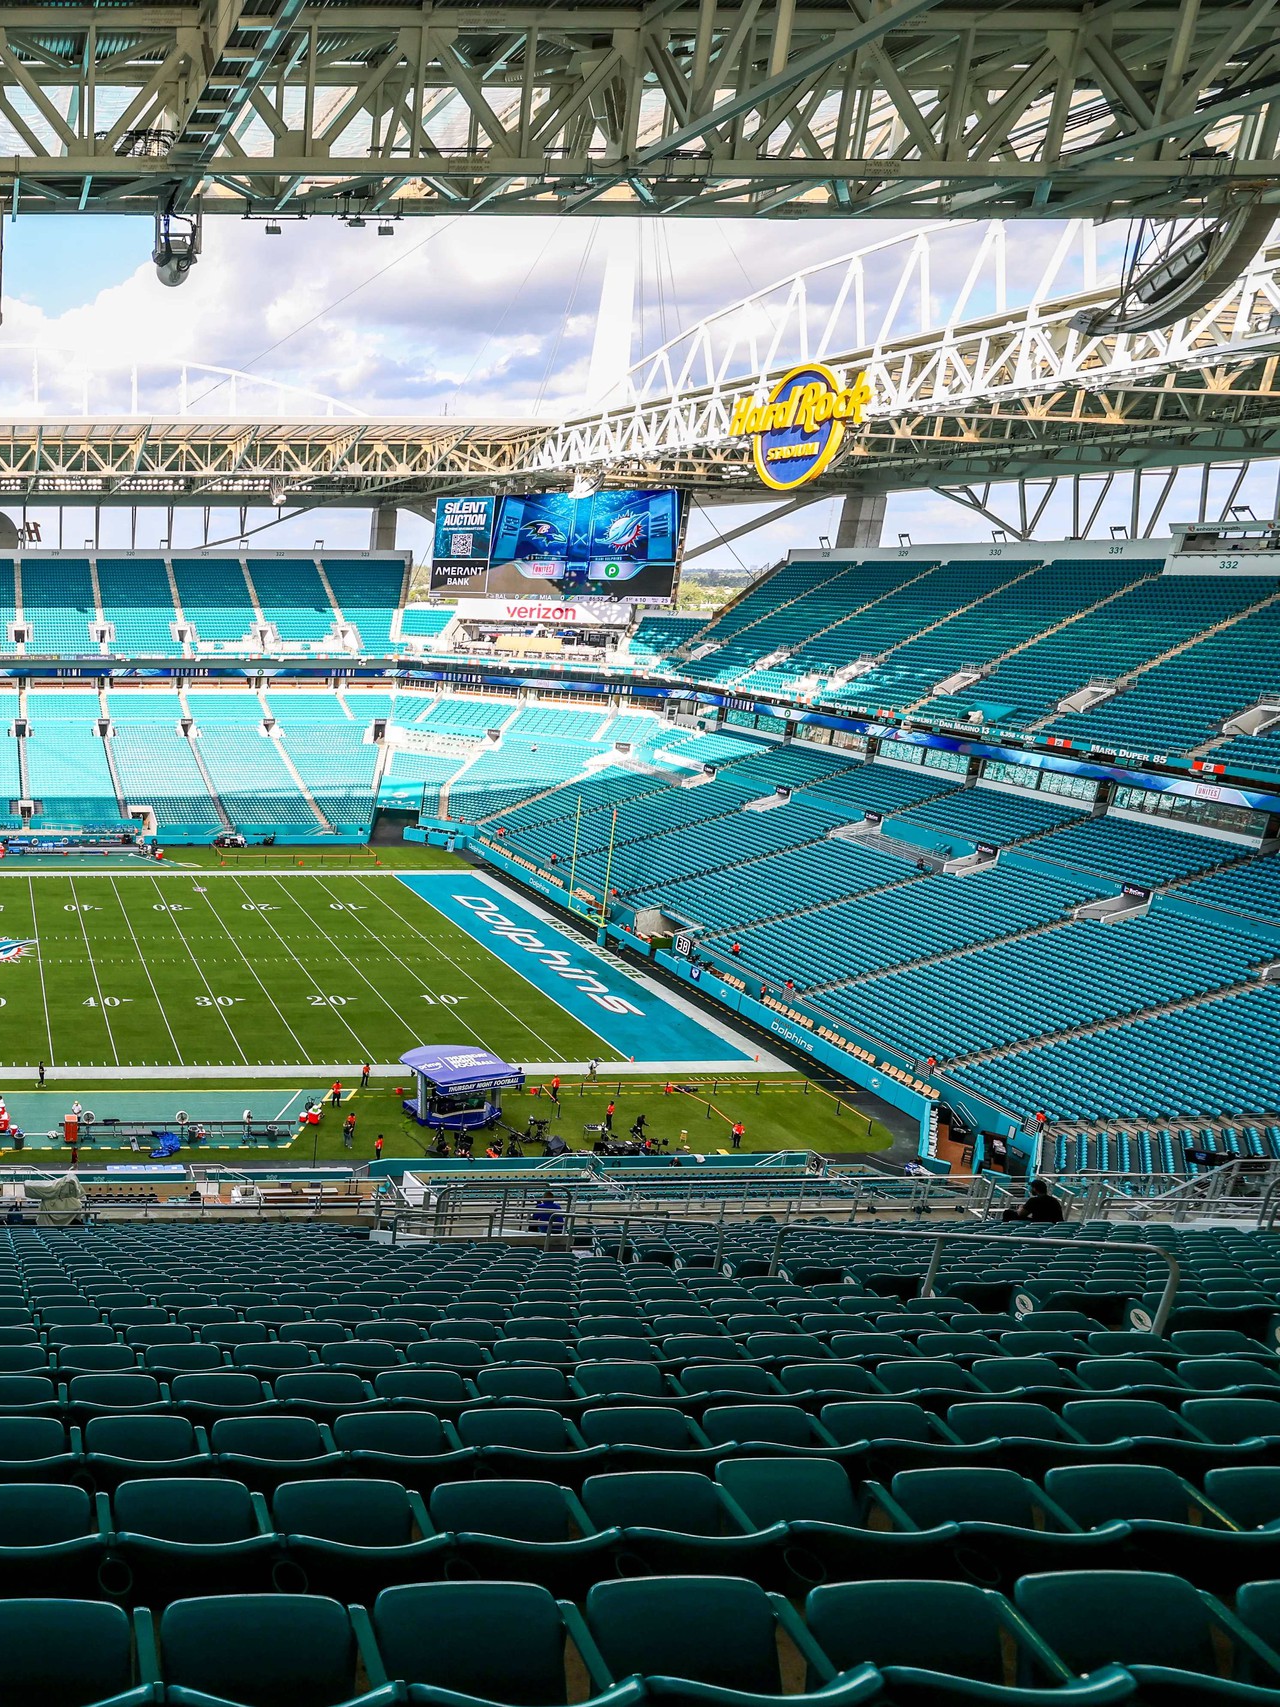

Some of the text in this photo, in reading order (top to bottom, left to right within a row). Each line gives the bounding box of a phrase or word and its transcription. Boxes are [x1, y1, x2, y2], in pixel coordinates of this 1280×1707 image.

[728, 372, 872, 436] Hard Rock
[767, 442, 820, 461] STADIUM
[444, 501, 487, 514] SILENT
[444, 514, 486, 526] AUCTION
[650, 513, 669, 538] MIA
[502, 516, 519, 539] BAL
[435, 567, 484, 576] AMERANT
[535, 565, 552, 573] UNITES
[1219, 561, 1239, 569] 332
[507, 604, 576, 620] verizon
[834, 702, 858, 712] CLAYTON
[939, 720, 990, 734] DAN MARINO 13
[1091, 744, 1167, 764] MARK DUPER 85
[1198, 788, 1218, 797] UNITES
[529, 877, 550, 894] Dolphins
[543, 918, 647, 980] INSPIRE CHANGE
[679, 937, 688, 953] 38
[451, 895, 646, 1016] Dolphins
[82, 997, 121, 1007] 40
[194, 995, 234, 1006] 30
[306, 995, 347, 1006] 20
[420, 994, 461, 1005] 10
[770, 1021, 814, 1052] Dolphins
[417, 1062, 442, 1070] prime
[448, 1077, 519, 1093] THURSDAY NIGHT FOOTBALL
